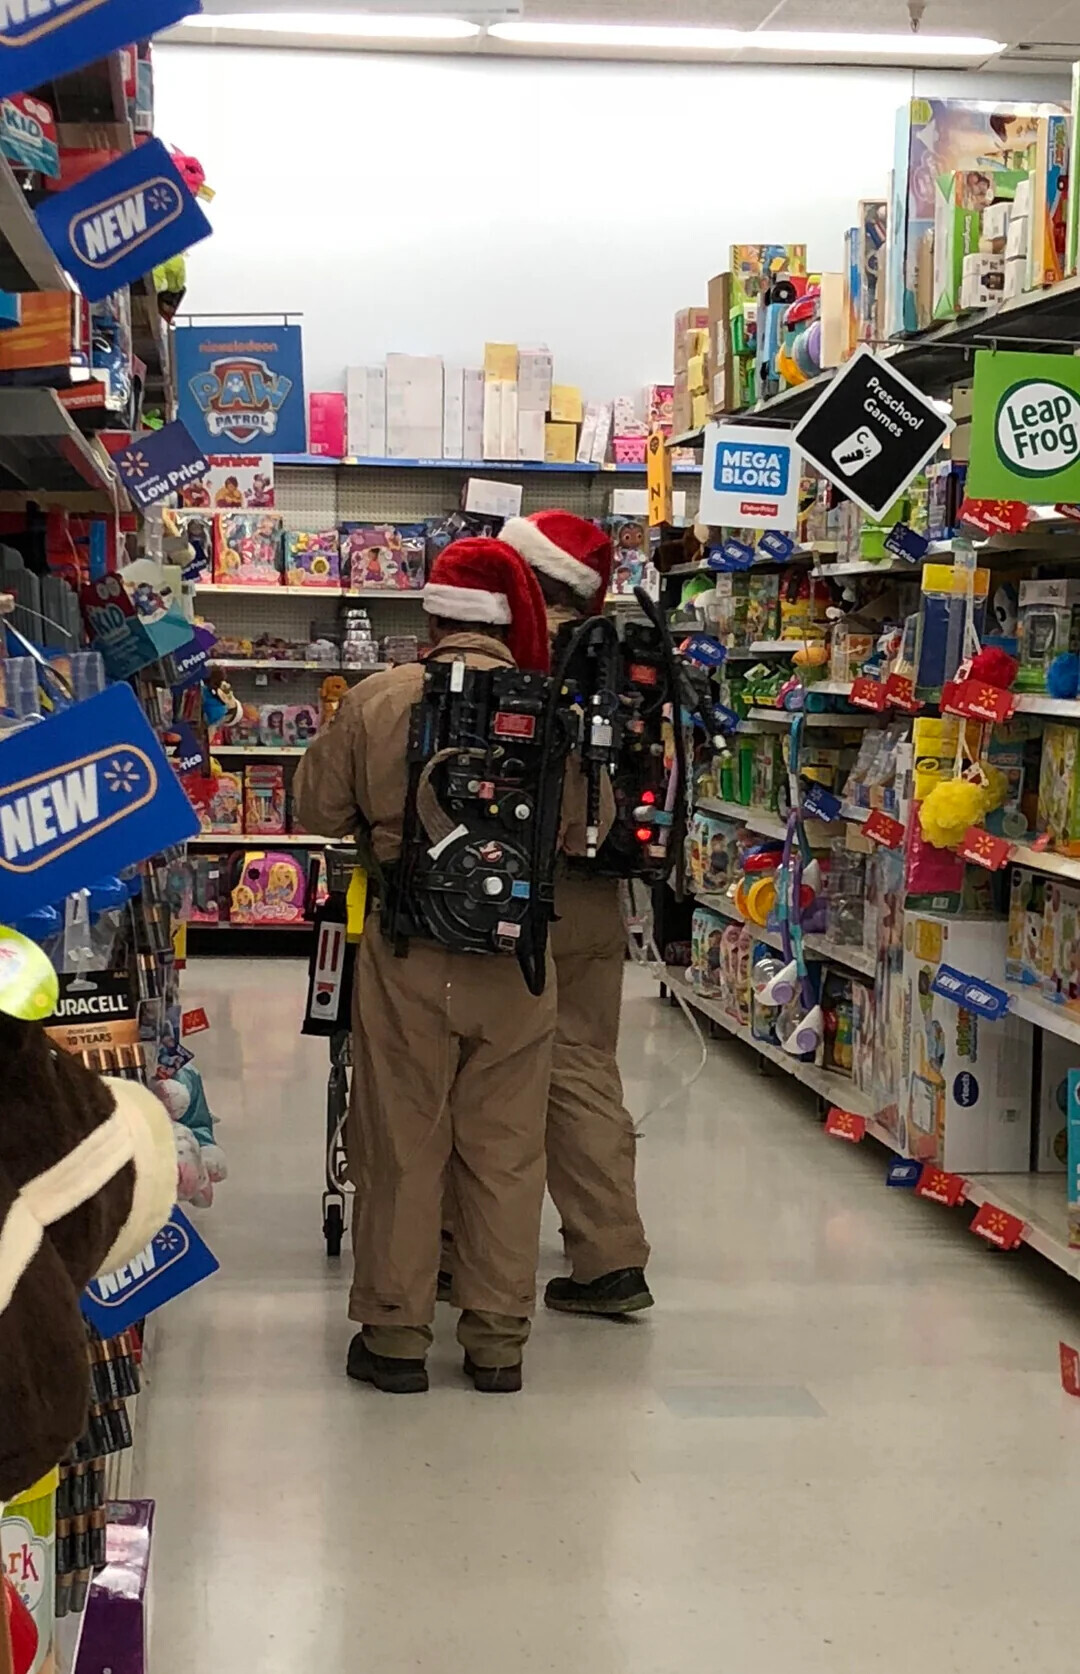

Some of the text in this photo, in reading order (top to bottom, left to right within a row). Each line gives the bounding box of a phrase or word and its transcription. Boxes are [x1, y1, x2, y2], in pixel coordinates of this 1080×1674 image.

[82, 192, 147, 260] NEW
[188, 370, 292, 411] PAW
[866, 376, 925, 430] Preschool
[215, 414, 269, 428] PATROL
[863, 398, 903, 437] Games
[1006, 395, 1072, 431] Leap
[1013, 423, 1079, 459] Frog
[722, 449, 780, 470] MEGA
[135, 479, 169, 502] Low
[167, 460, 206, 486] Price
[721, 467, 781, 488] BLOKS
[651, 483, 661, 502] N
[654, 506, 659, 520] 1
[91, 606, 124, 634] KID
[182, 651, 206, 669] Price
[0, 763, 99, 861] NEW
[938, 975, 962, 991] NEW
[967, 988, 992, 1005] NEW
[54, 994, 129, 1017] URACELL
[66, 1032, 113, 1046] 10 YEARS
[97, 1240, 156, 1300] NEW
[3, 1543, 39, 1581] rk
